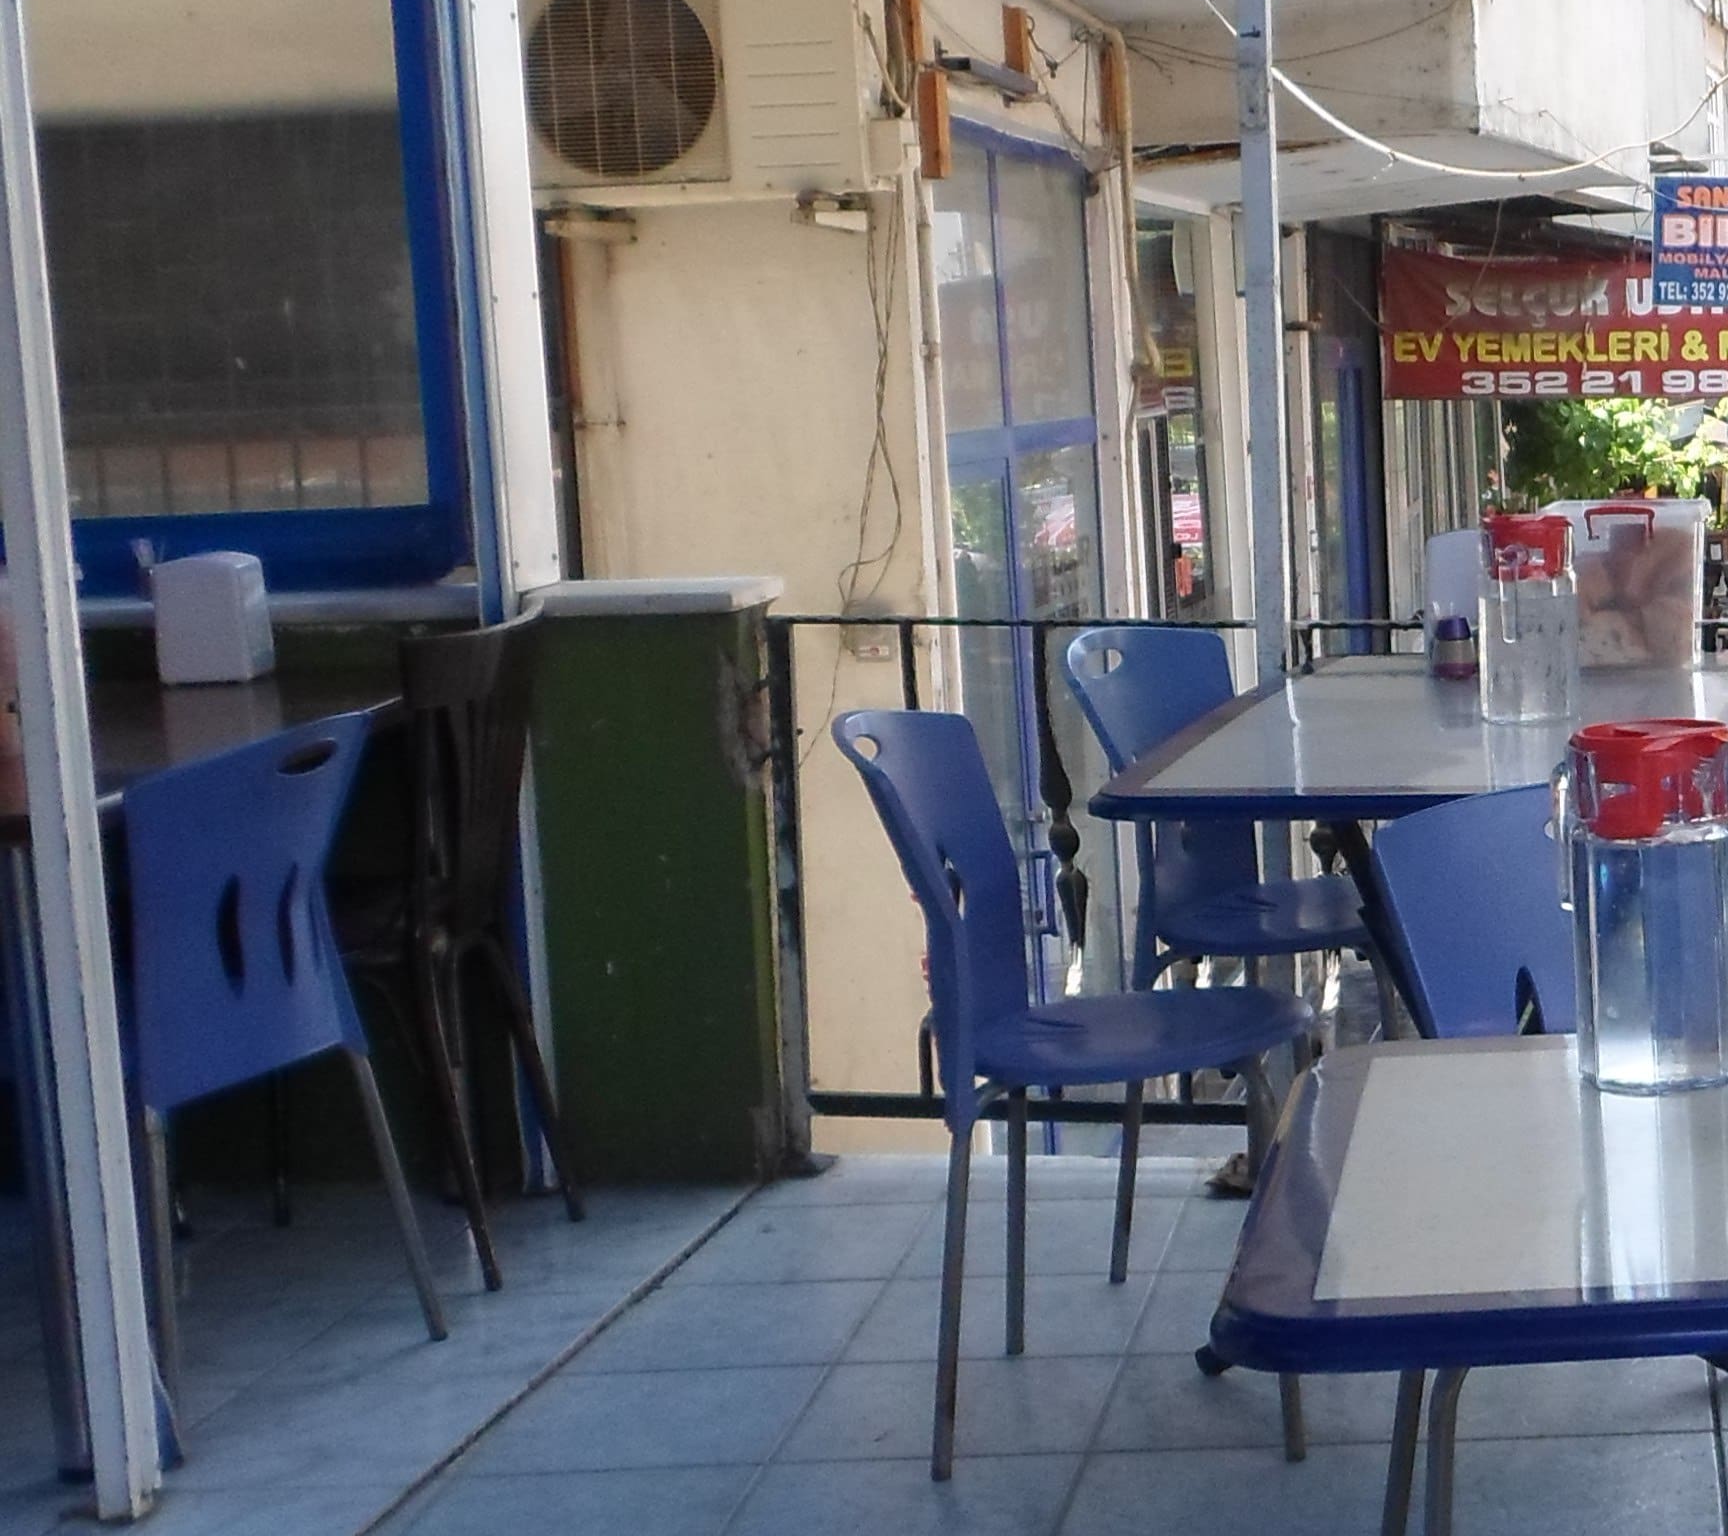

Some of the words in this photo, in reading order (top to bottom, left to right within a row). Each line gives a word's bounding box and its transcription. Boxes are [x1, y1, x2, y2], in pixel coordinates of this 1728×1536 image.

[1658, 281, 1688, 301] TEL:
[1690, 281, 1716, 301] 352
[1393, 331, 1444, 363] EV
[1452, 323, 1670, 363] YEMEKLERİ
[1680, 328, 1710, 362] &
[1460, 370, 1569, 395] 352
[1580, 369, 1643, 395] 21
